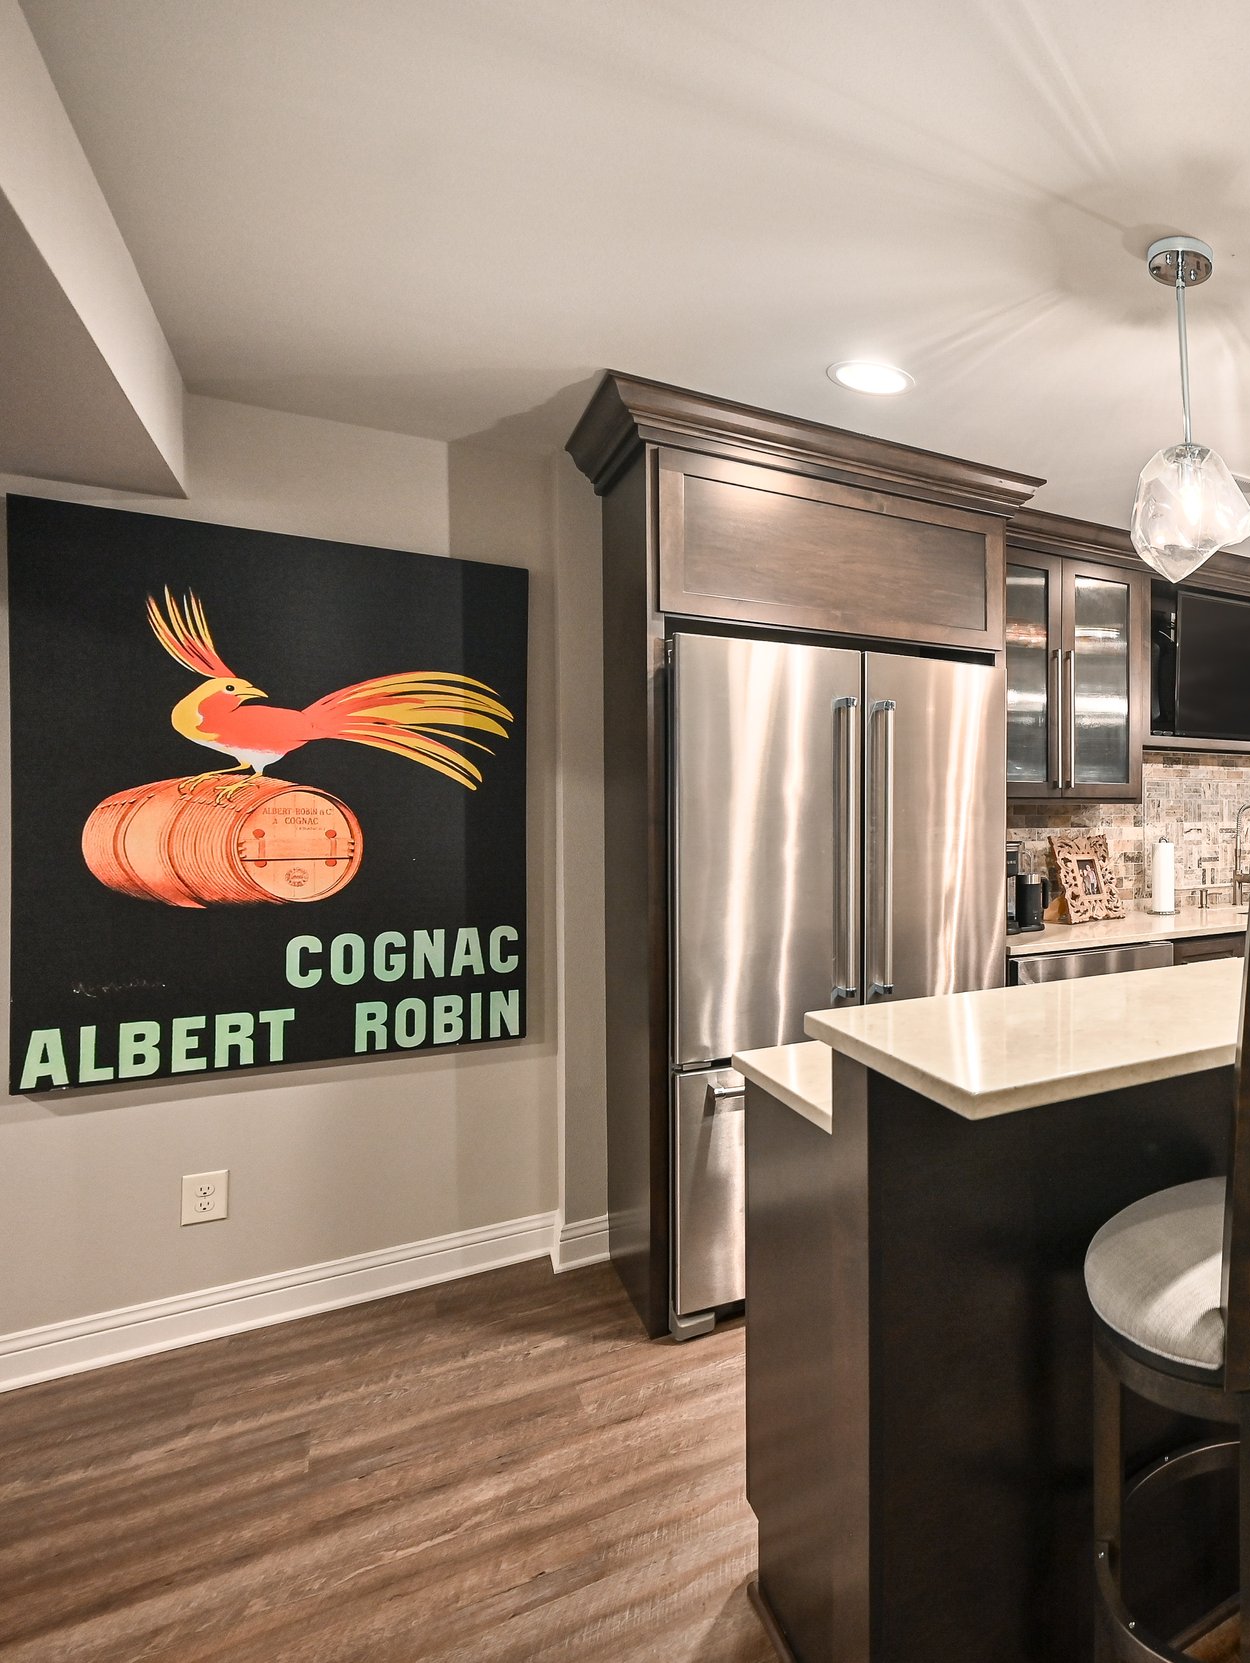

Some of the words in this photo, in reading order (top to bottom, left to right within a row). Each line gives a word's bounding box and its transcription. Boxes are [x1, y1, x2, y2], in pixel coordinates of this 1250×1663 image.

[262, 807, 292, 815] ALBERT
[284, 817, 319, 825] COGNAC
[286, 925, 519, 989] COGNAC
[20, 1008, 295, 1090] ALBERT
[355, 989, 520, 1054] ROBIN
